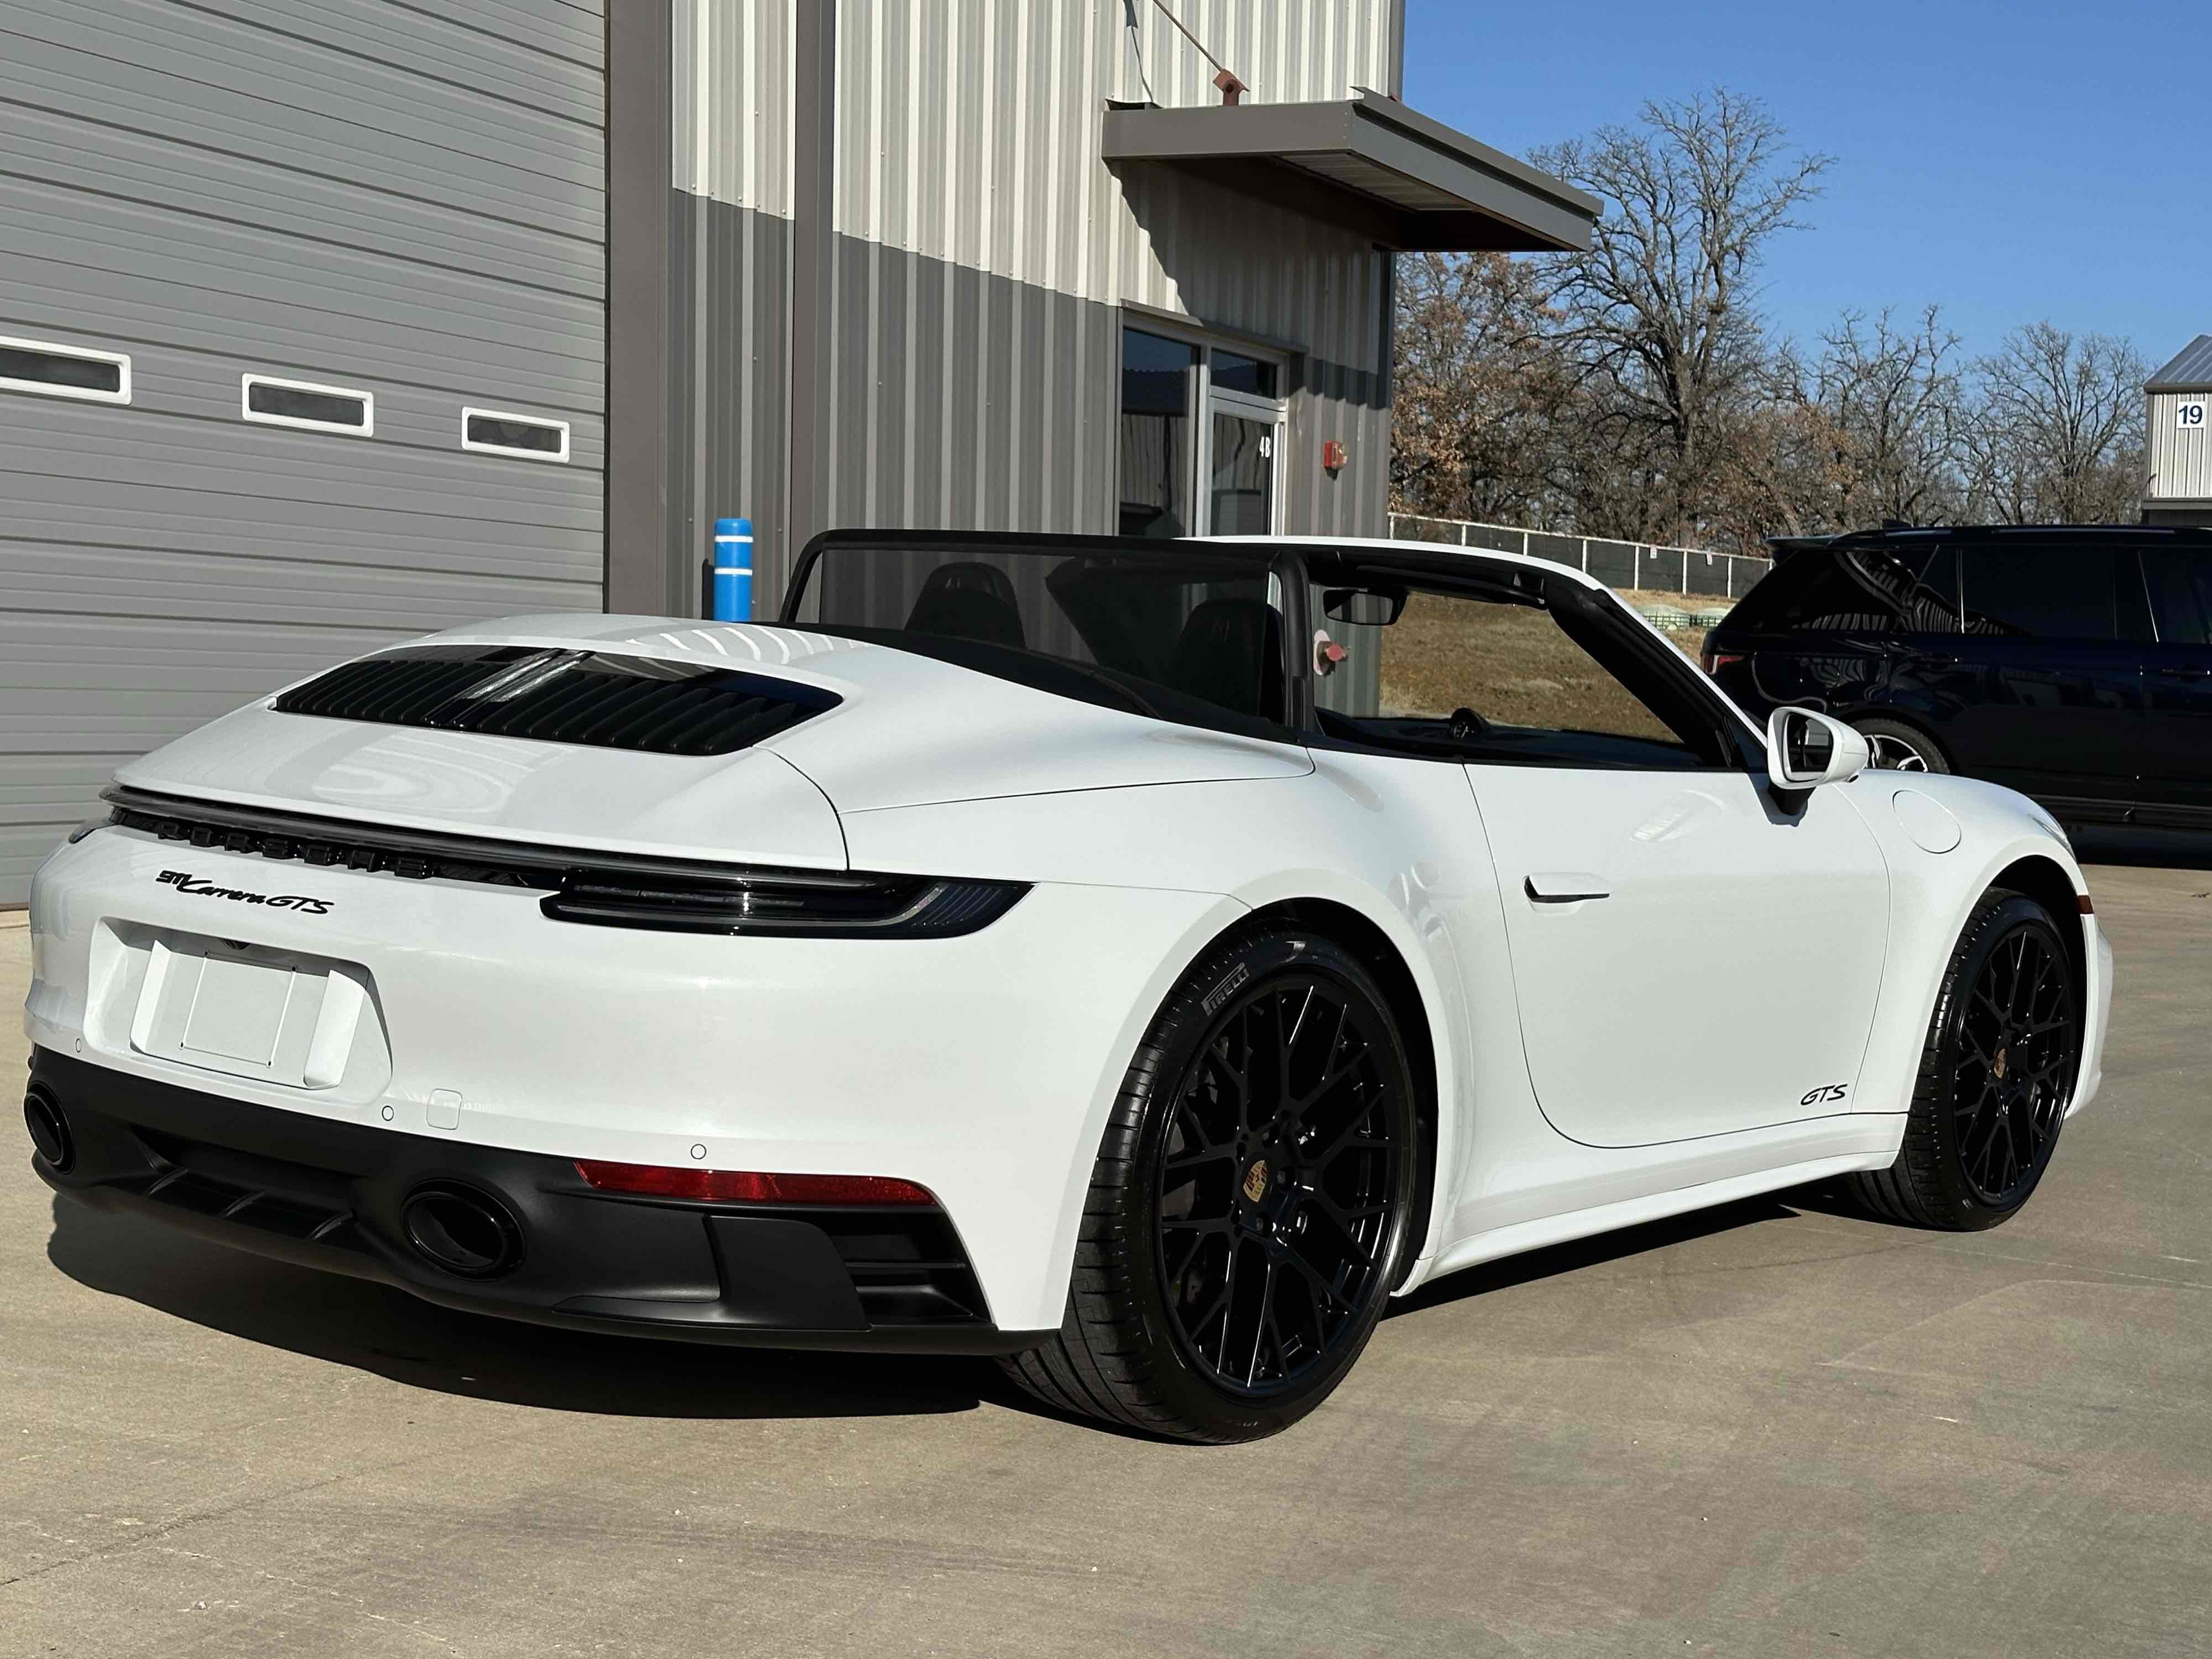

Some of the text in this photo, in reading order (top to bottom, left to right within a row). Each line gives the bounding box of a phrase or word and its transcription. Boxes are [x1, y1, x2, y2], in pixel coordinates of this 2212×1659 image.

[2178, 405, 2203, 425] 19
[1259, 436, 1271, 458] 4B
[176, 879, 266, 904] Carrera
[266, 895, 335, 914] GTS
[1201, 962, 1250, 1016] PIRELLI
[1800, 1083, 1848, 1105] GTS
